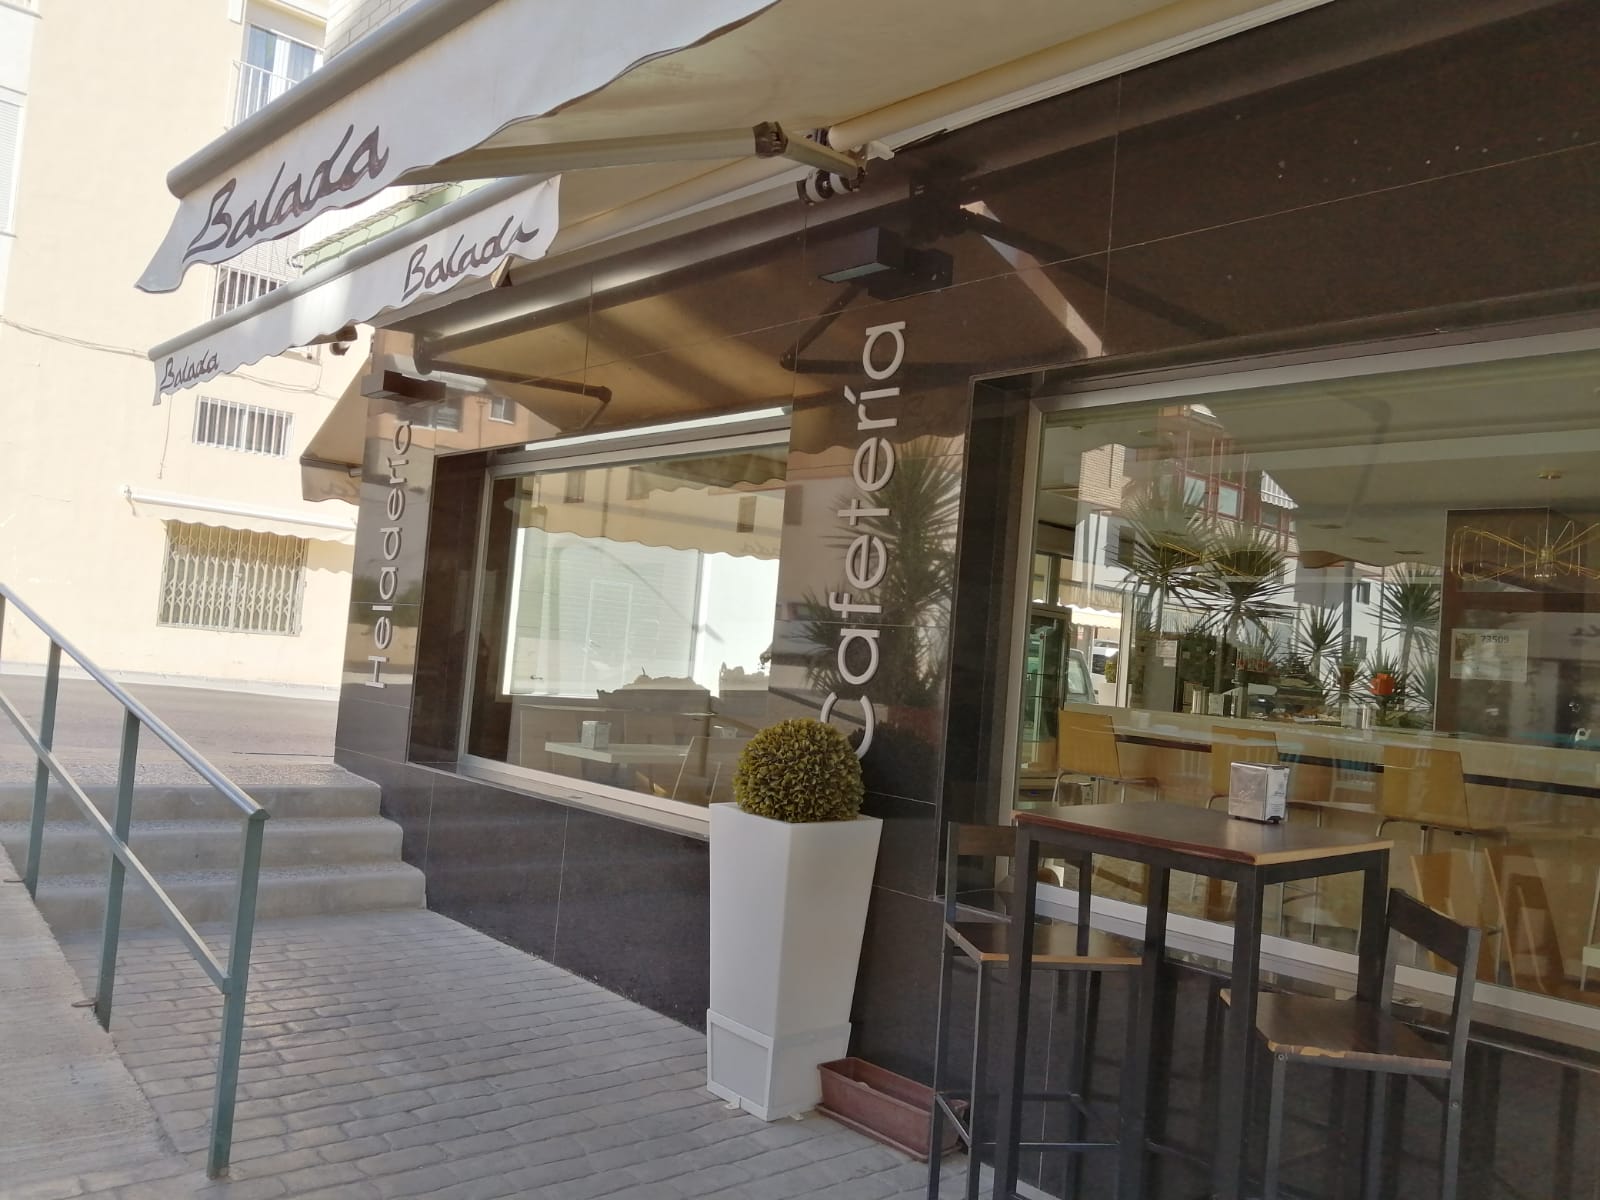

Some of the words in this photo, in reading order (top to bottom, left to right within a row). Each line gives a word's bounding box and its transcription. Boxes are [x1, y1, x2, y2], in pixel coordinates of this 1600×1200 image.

[182, 124, 390, 264] Balada
[400, 214, 540, 302] Balada
[159, 348, 219, 392] Balada
[364, 420, 412, 689] Heladería
[820, 320, 906, 761] Cafetería
